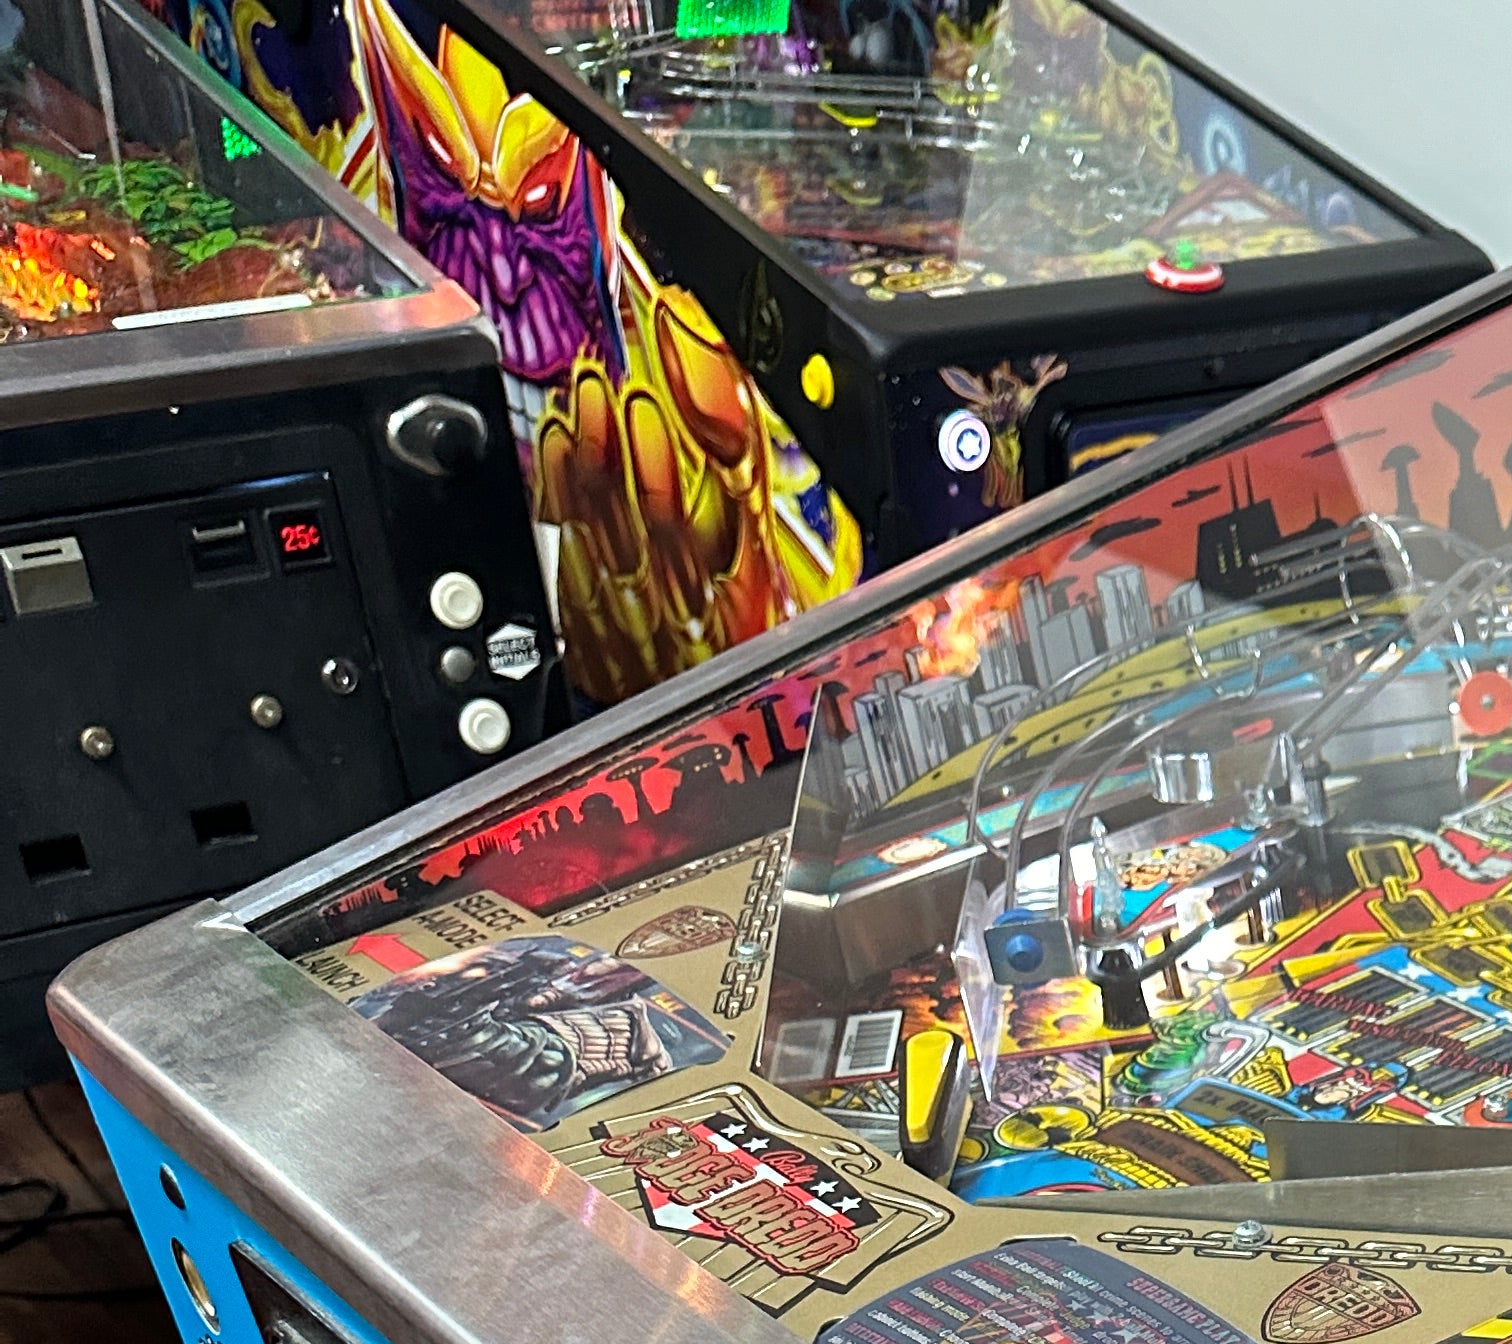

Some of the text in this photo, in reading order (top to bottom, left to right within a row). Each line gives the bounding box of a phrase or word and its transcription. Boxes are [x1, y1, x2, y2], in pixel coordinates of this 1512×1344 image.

[281, 524, 321, 552] 25¢
[295, 950, 370, 994] LAUNCH
[600, 1116, 861, 1277] JDGE DREDD
[1298, 1276, 1396, 1330] DREDD
